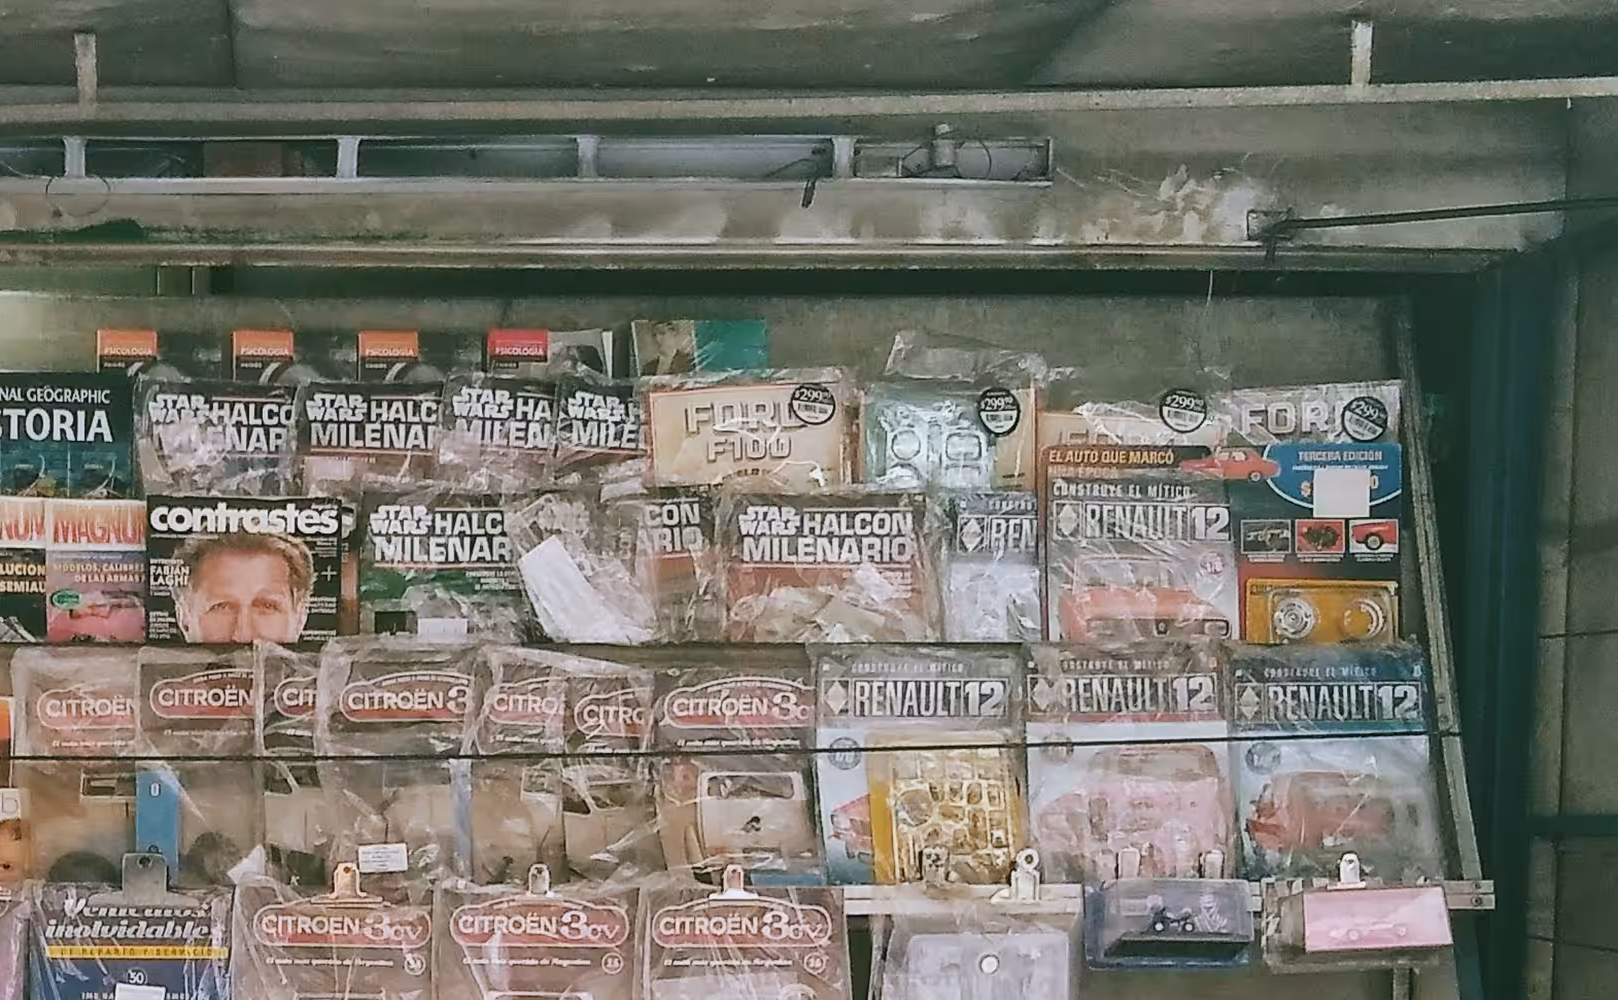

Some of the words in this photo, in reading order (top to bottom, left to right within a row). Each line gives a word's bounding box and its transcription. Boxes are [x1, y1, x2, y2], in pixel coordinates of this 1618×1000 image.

[26, 387, 110, 405] GEOGRAPHIC
[156, 394, 208, 409] STAR
[314, 393, 366, 408] STAR
[461, 387, 512, 404] STAR
[575, 392, 623, 408] STAR
[306, 403, 367, 422] WARS
[453, 401, 513, 418] WARS
[1049, 451, 1062, 462] EL
[1065, 451, 1098, 463] AUTO
[1101, 451, 1126, 463] QUE
[1128, 449, 1174, 465] MARCÓ
[1129, 485, 1141, 496] EL
[150, 502, 338, 534] contrastes
[378, 505, 431, 520] STAR
[745, 505, 801, 520] STAR
[370, 519, 431, 535] WARS
[739, 518, 801, 535] WARS
[803, 511, 913, 536] HALCON
[1087, 505, 1187, 539] RENAULT
[1192, 507, 1229, 540] 12
[743, 537, 914, 563] MILENARIO
[158, 684, 253, 707] CITROËN
[348, 690, 443, 710] CITROËN
[855, 681, 961, 716] RENAULT
[964, 682, 1004, 715] 12
[1066, 677, 1168, 712] RENAULT
[1173, 677, 1215, 710] 12
[1268, 686, 1375, 720] RENAULT
[1378, 685, 1420, 719] 12
[673, 693, 769, 716] CITROËN
[458, 915, 558, 935] CITROËN
[659, 915, 758, 935] CITROËN
